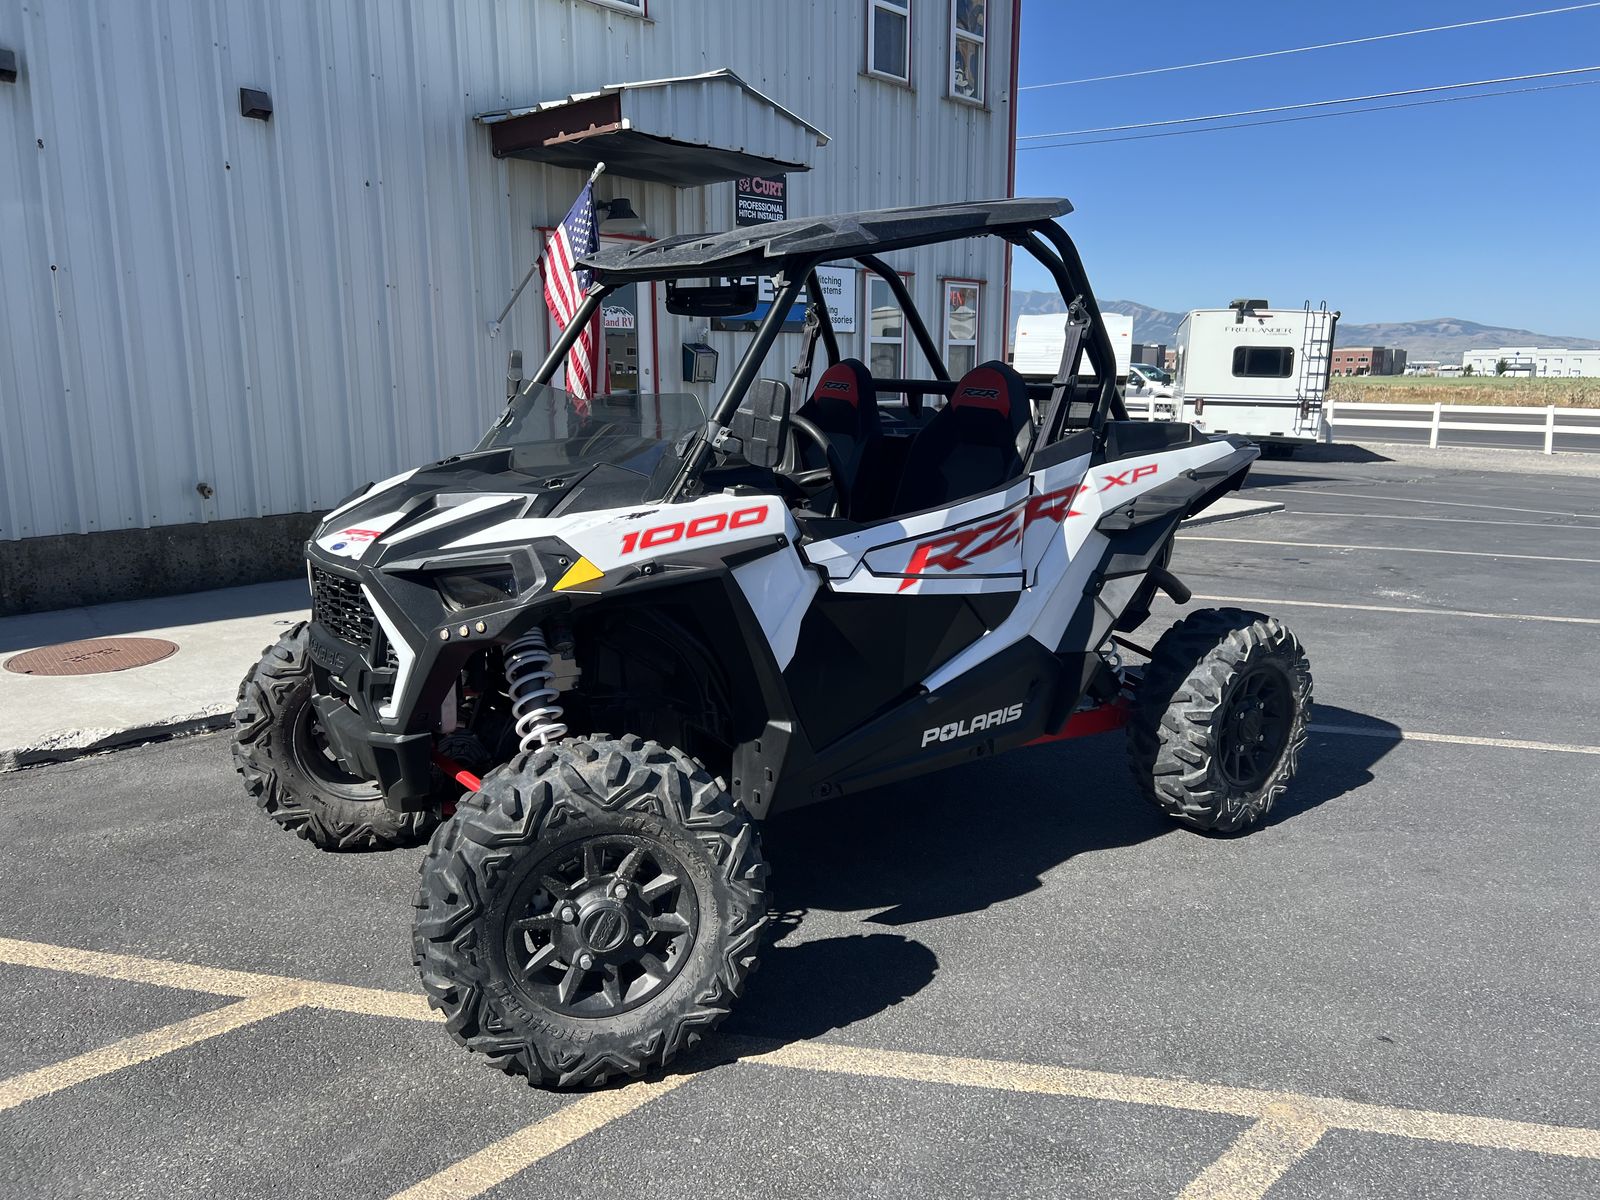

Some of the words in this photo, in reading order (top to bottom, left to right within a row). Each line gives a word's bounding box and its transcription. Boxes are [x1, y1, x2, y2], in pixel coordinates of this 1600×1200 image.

[752, 177, 784, 196] CURT
[739, 200, 784, 213] PROFESSIONAL
[739, 209, 756, 219] HITCH
[757, 211, 784, 222] INSTALLER
[818, 276, 842, 288] itching
[603, 316, 619, 327] land
[621, 317, 633, 328] RV
[823, 381, 851, 392] RZR
[961, 388, 1000, 400] RZR
[1096, 463, 1158, 493] XP
[619, 505, 768, 557] 1000
[897, 483, 1088, 593] RZR
[921, 702, 1024, 748] POLARIS
